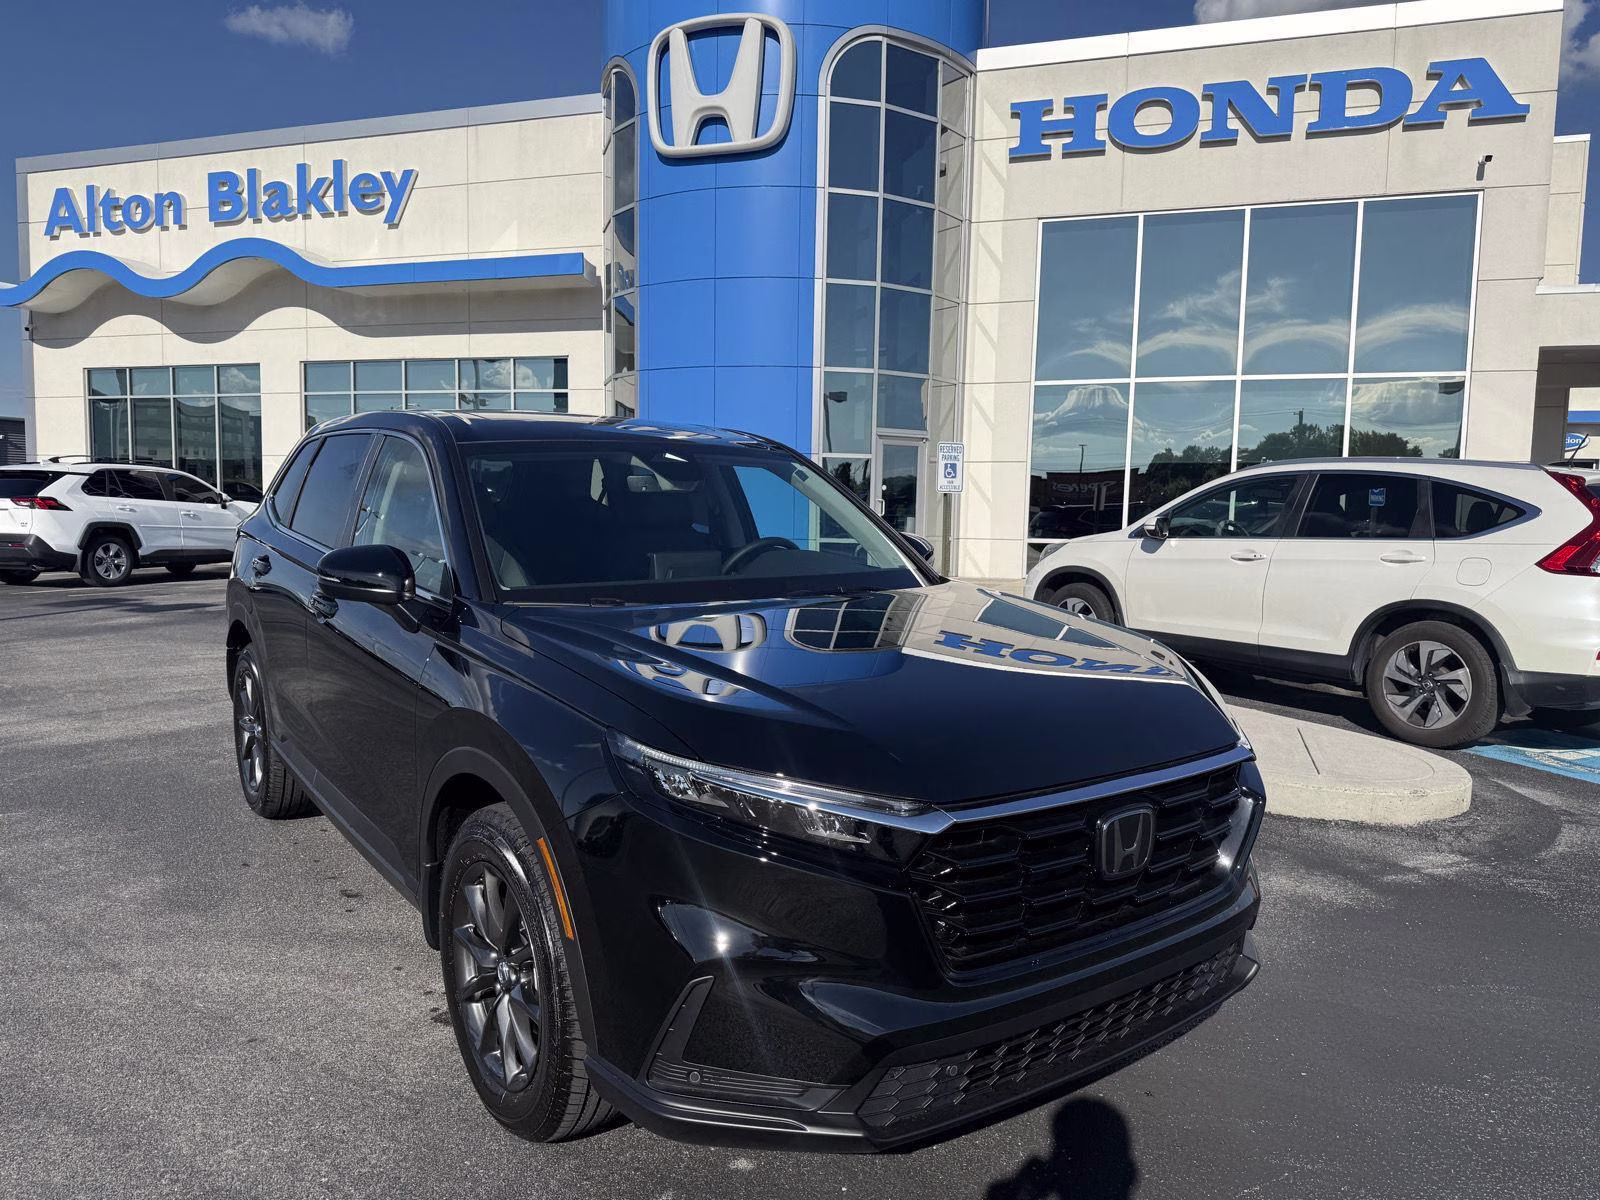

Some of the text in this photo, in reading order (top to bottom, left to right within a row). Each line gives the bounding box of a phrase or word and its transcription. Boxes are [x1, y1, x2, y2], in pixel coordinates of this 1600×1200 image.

[1009, 57, 1531, 161] HONDA
[44, 158, 418, 239] Alton Blakley
[940, 445, 962, 454] RESERVED
[941, 454, 960, 462] PARKING
